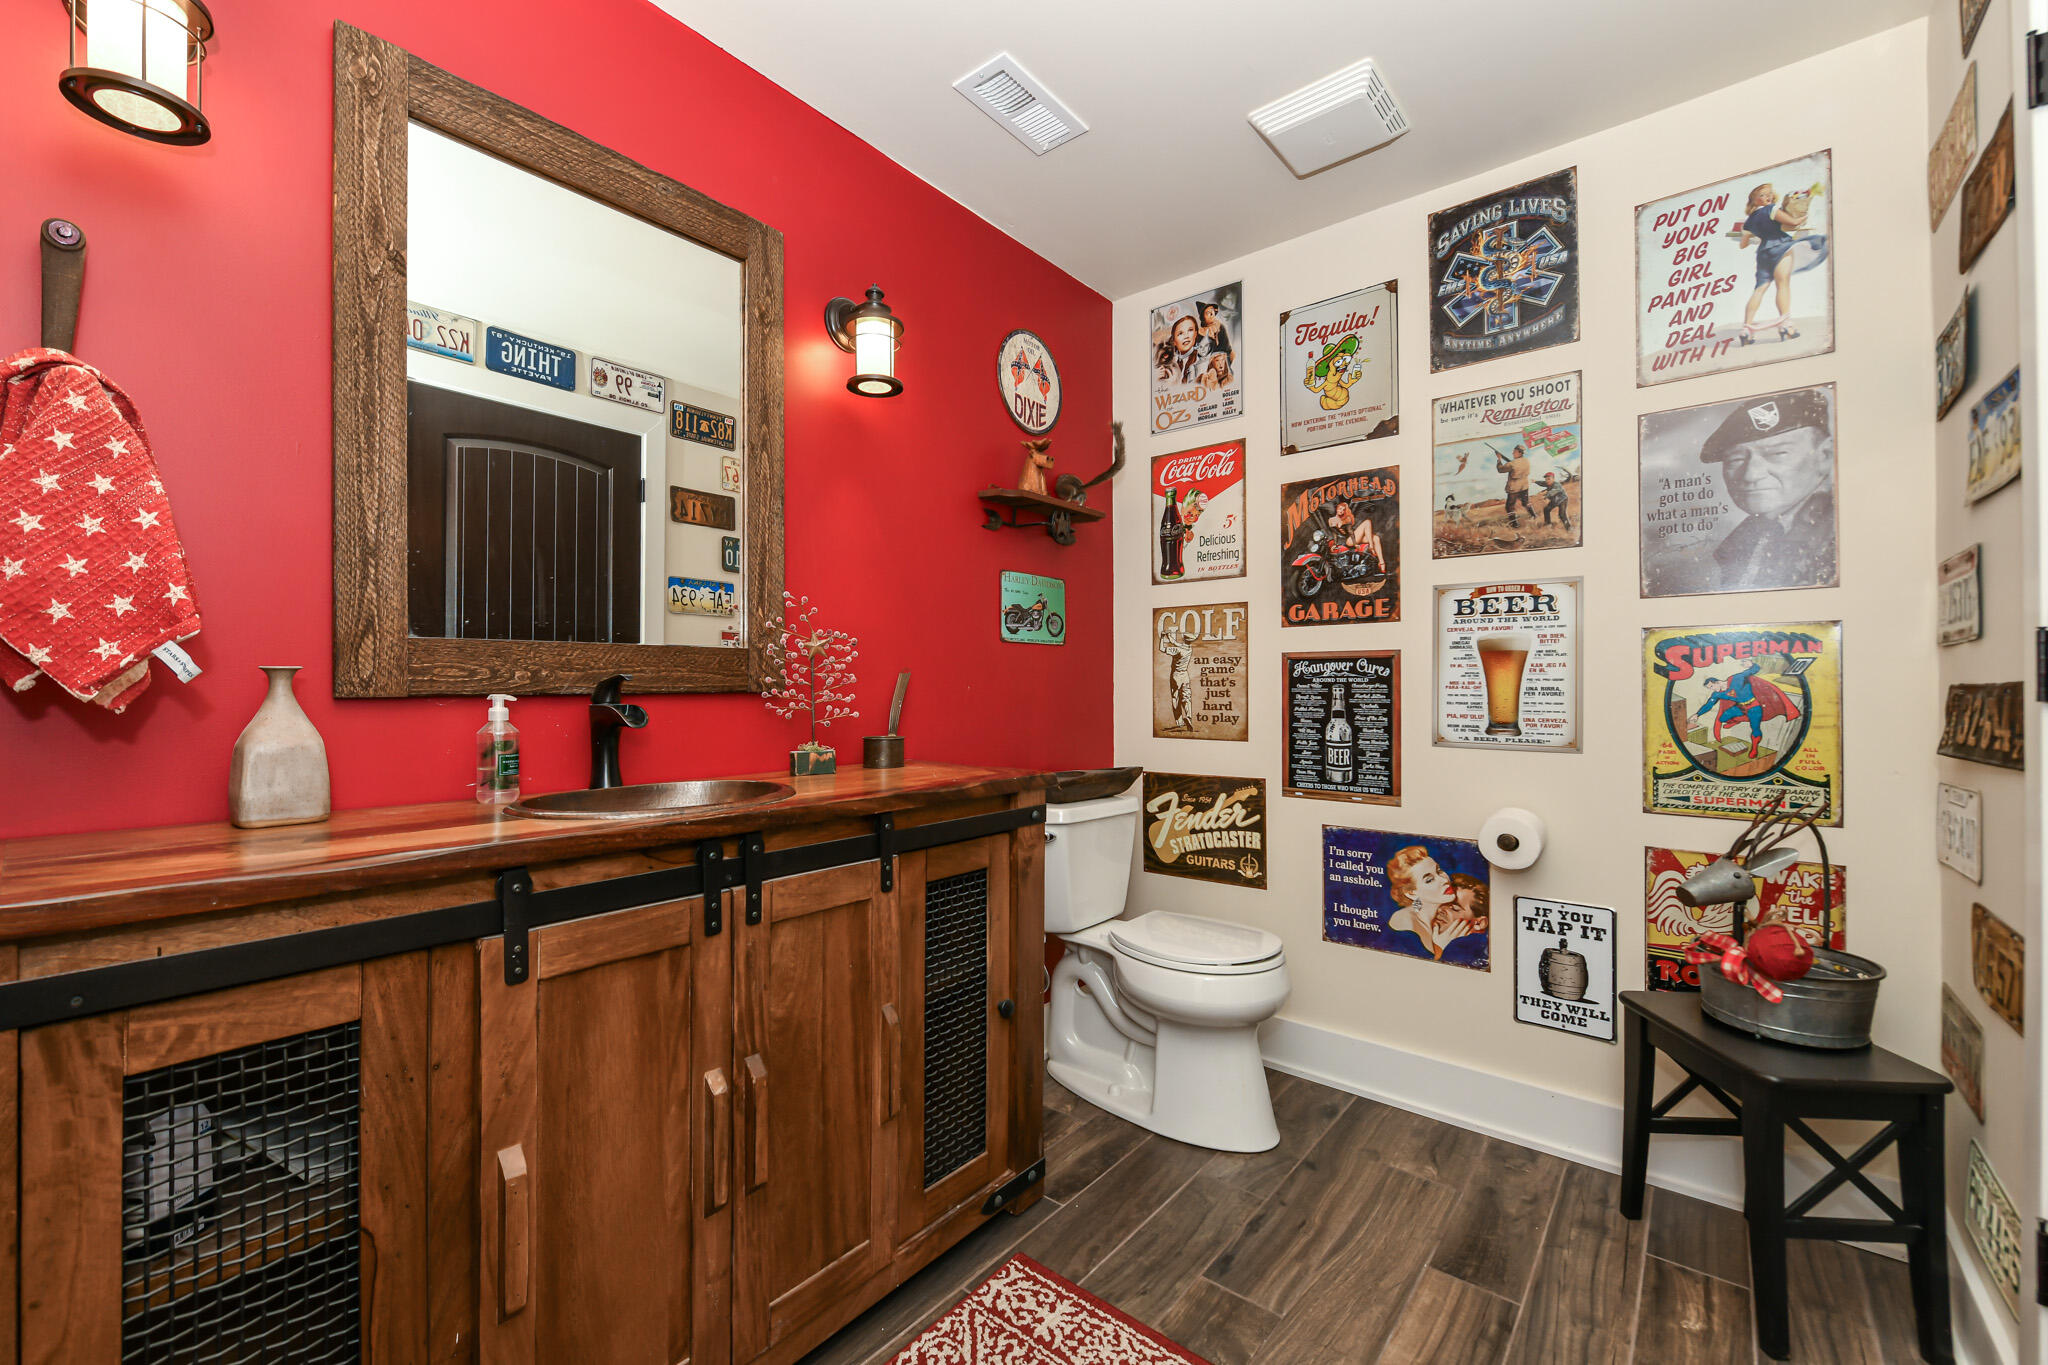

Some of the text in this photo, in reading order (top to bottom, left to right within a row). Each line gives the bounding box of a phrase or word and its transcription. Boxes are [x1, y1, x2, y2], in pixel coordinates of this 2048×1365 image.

[1653, 193, 1730, 232] PUT ON
[1436, 197, 1569, 260] SAVING LIVES
[1662, 218, 1720, 249] YOUR
[1672, 242, 1709, 265] BIG
[1668, 261, 1713, 287] GIRL
[1648, 274, 1737, 313] PANTIES
[1668, 302, 1714, 328] AND
[1295, 305, 1380, 346] Tequila!
[1443, 304, 1567, 350] ANYTIME ANYWHERE
[1665, 322, 1717, 349] DEAL
[1652, 337, 1735, 372] WITH IT
[1155, 386, 1207, 411] WIZARD
[1440, 379, 1571, 414] WHATEVER YOU SHOOT
[1014, 392, 1047, 428] DIXIE
[1156, 409, 1191, 430] OZ
[1480, 398, 1575, 425] Remington
[1160, 447, 1239, 487] Coca-Cola
[1178, 455, 1203, 464] DRINK
[1674, 472, 1712, 488] man's
[1659, 487, 1714, 508] got to do
[1284, 476, 1396, 550] MOTORHEAD
[1647, 502, 1729, 522] what a man's
[1658, 524, 1679, 538] got
[1682, 522, 1694, 532] to
[1199, 534, 1237, 547] Delicious
[1197, 548, 1240, 562] Refreshing
[1208, 563, 1239, 571] BOTTLES
[1288, 598, 1391, 622] GARAGE
[1453, 594, 1560, 618] BEER
[1157, 607, 1245, 642] GOLF
[1453, 617, 1494, 625] AROUND
[1522, 615, 1560, 623] WORLD
[1194, 655, 1241, 666] an easy
[1293, 658, 1390, 678] Hangover Cures
[1660, 637, 1823, 681] SUPERMAN
[1200, 666, 1235, 676] game
[1200, 677, 1236, 687] that's
[1205, 688, 1231, 700] just
[1202, 701, 1232, 710] hard
[1196, 712, 1240, 725] to play
[1328, 747, 1350, 765] BEER
[1678, 783, 1720, 791] COMPLETE
[1785, 788, 1821, 797] DARING
[1146, 791, 1260, 849] Fender
[1170, 830, 1261, 855] STRATOCASTER
[1186, 854, 1236, 870] GUITARS
[1329, 846, 1372, 861] I'm sorry
[1329, 859, 1384, 875] I called you
[1329, 873, 1383, 888] an asshole.
[1766, 870, 1836, 890] WAKE
[1785, 890, 1816, 905] the
[1334, 902, 1378, 919] I thought
[1534, 906, 1593, 924] IF YOU
[1333, 917, 1381, 932] you knew.
[1522, 916, 1607, 941] TAP IT
[1520, 995, 1610, 1022] THEY WILL
[1540, 1010, 1588, 1028] COME
